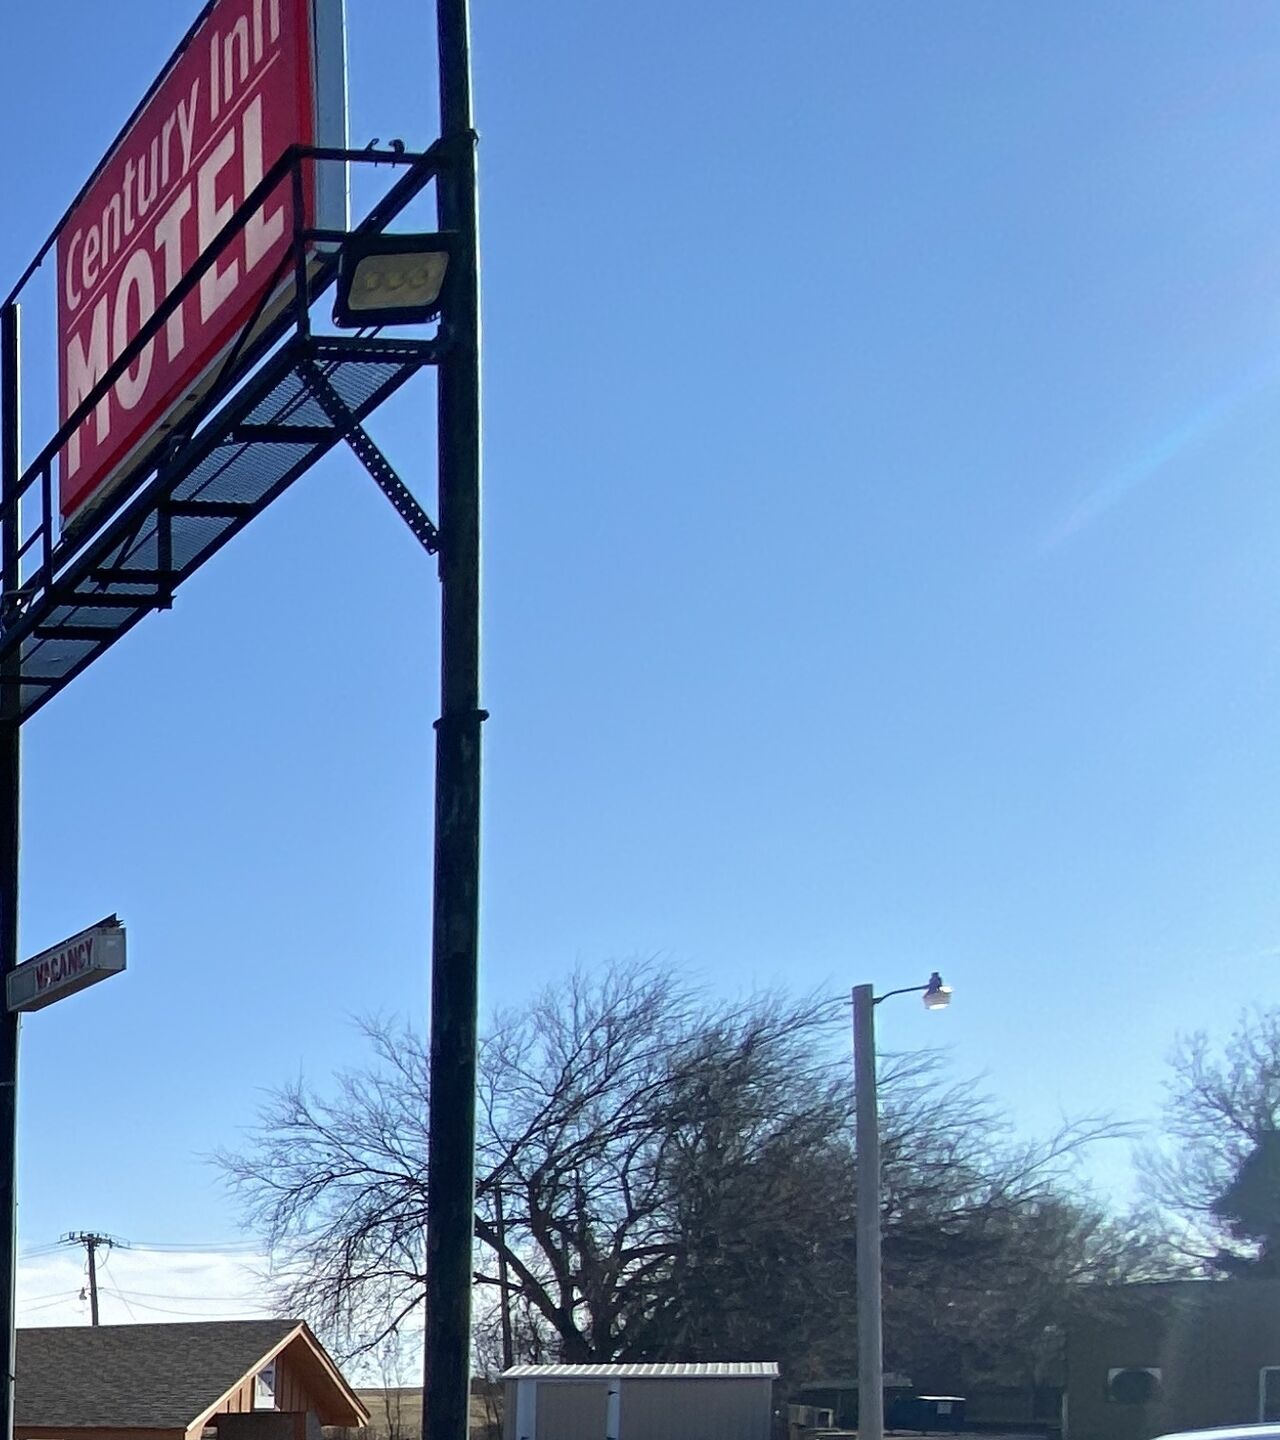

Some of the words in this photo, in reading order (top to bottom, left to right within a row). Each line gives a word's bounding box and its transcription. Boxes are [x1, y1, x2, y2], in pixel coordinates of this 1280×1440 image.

[65, 77, 200, 312] Century
[66, 92, 285, 481] MOTEL
[34, 937, 94, 991] VACANCY
